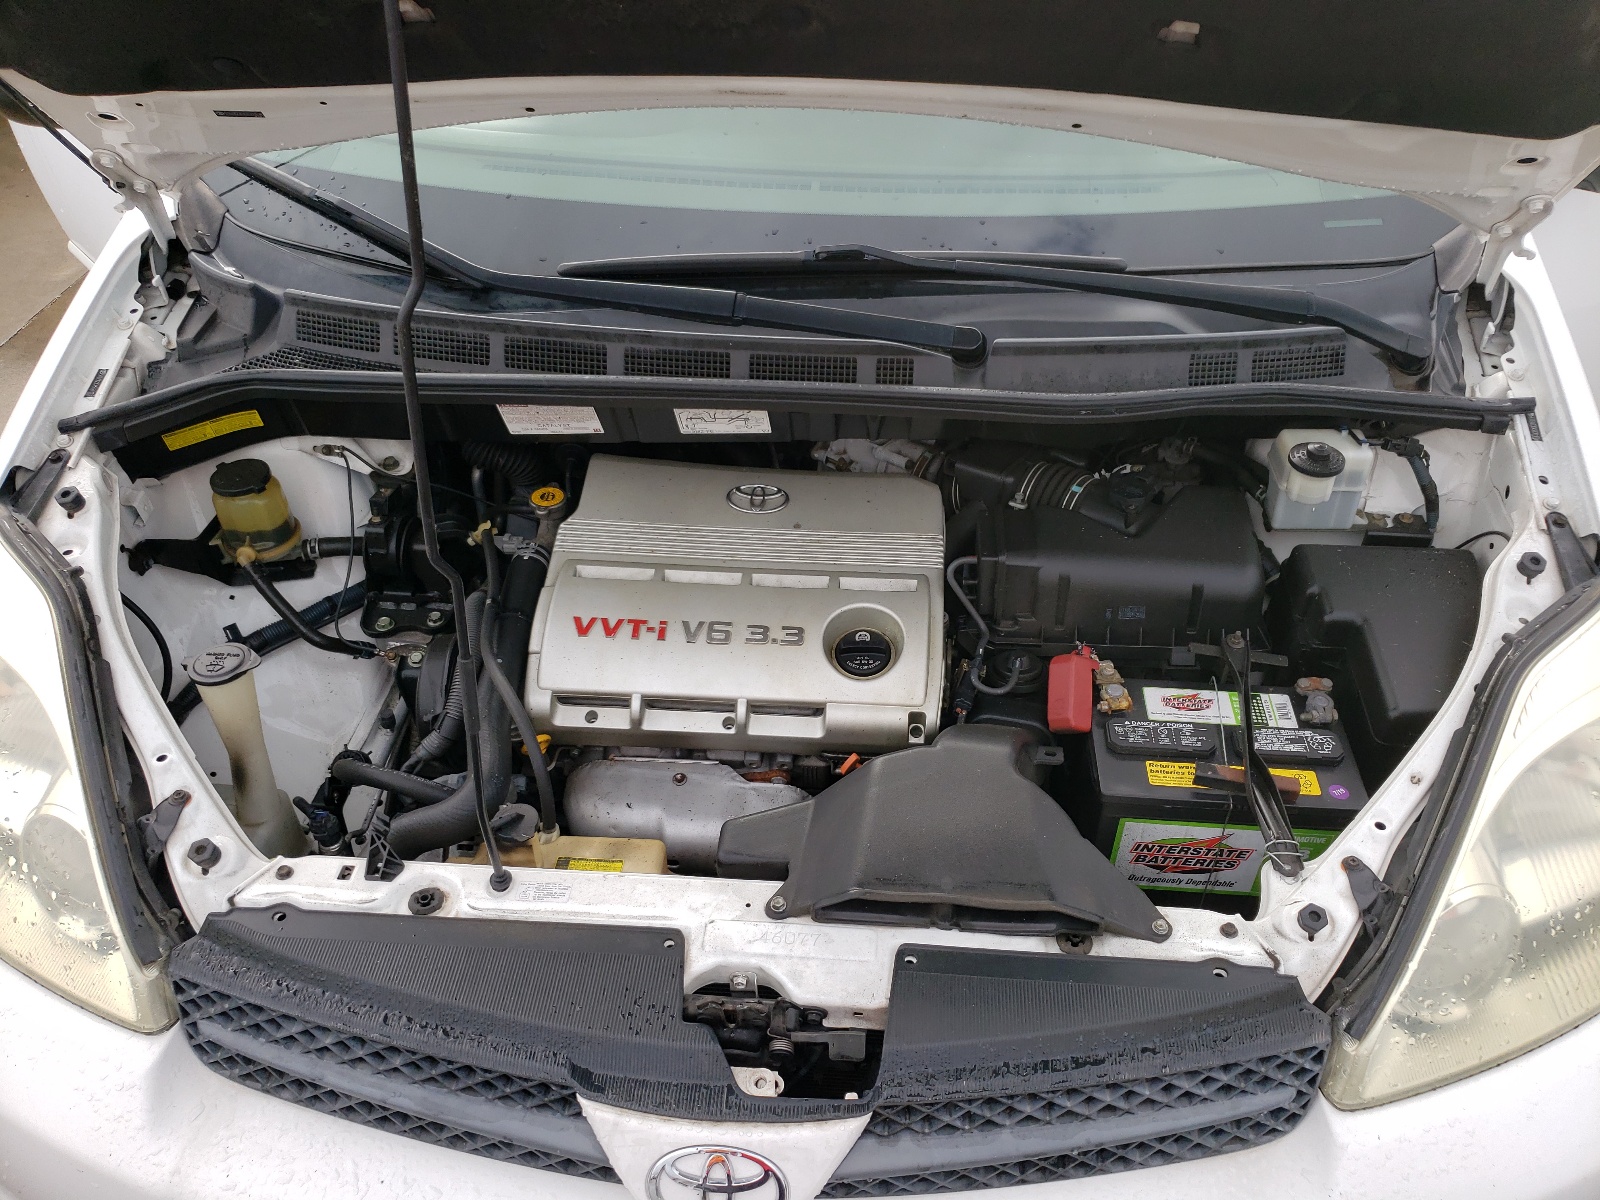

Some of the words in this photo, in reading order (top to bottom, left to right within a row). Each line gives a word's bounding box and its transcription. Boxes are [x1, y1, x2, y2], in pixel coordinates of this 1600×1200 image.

[573, 616, 669, 641] VVT-i
[681, 620, 733, 645] V6
[744, 624, 806, 646] 3.3
[1161, 696, 1214, 705] INTERSTATE
[1164, 701, 1211, 709] BATTERIES
[1132, 842, 1250, 860] INTERSTATE
[1133, 854, 1239, 869] BATTERIES
[1128, 874, 1184, 886] Outrageously
[1185, 876, 1236, 888] Dependable
